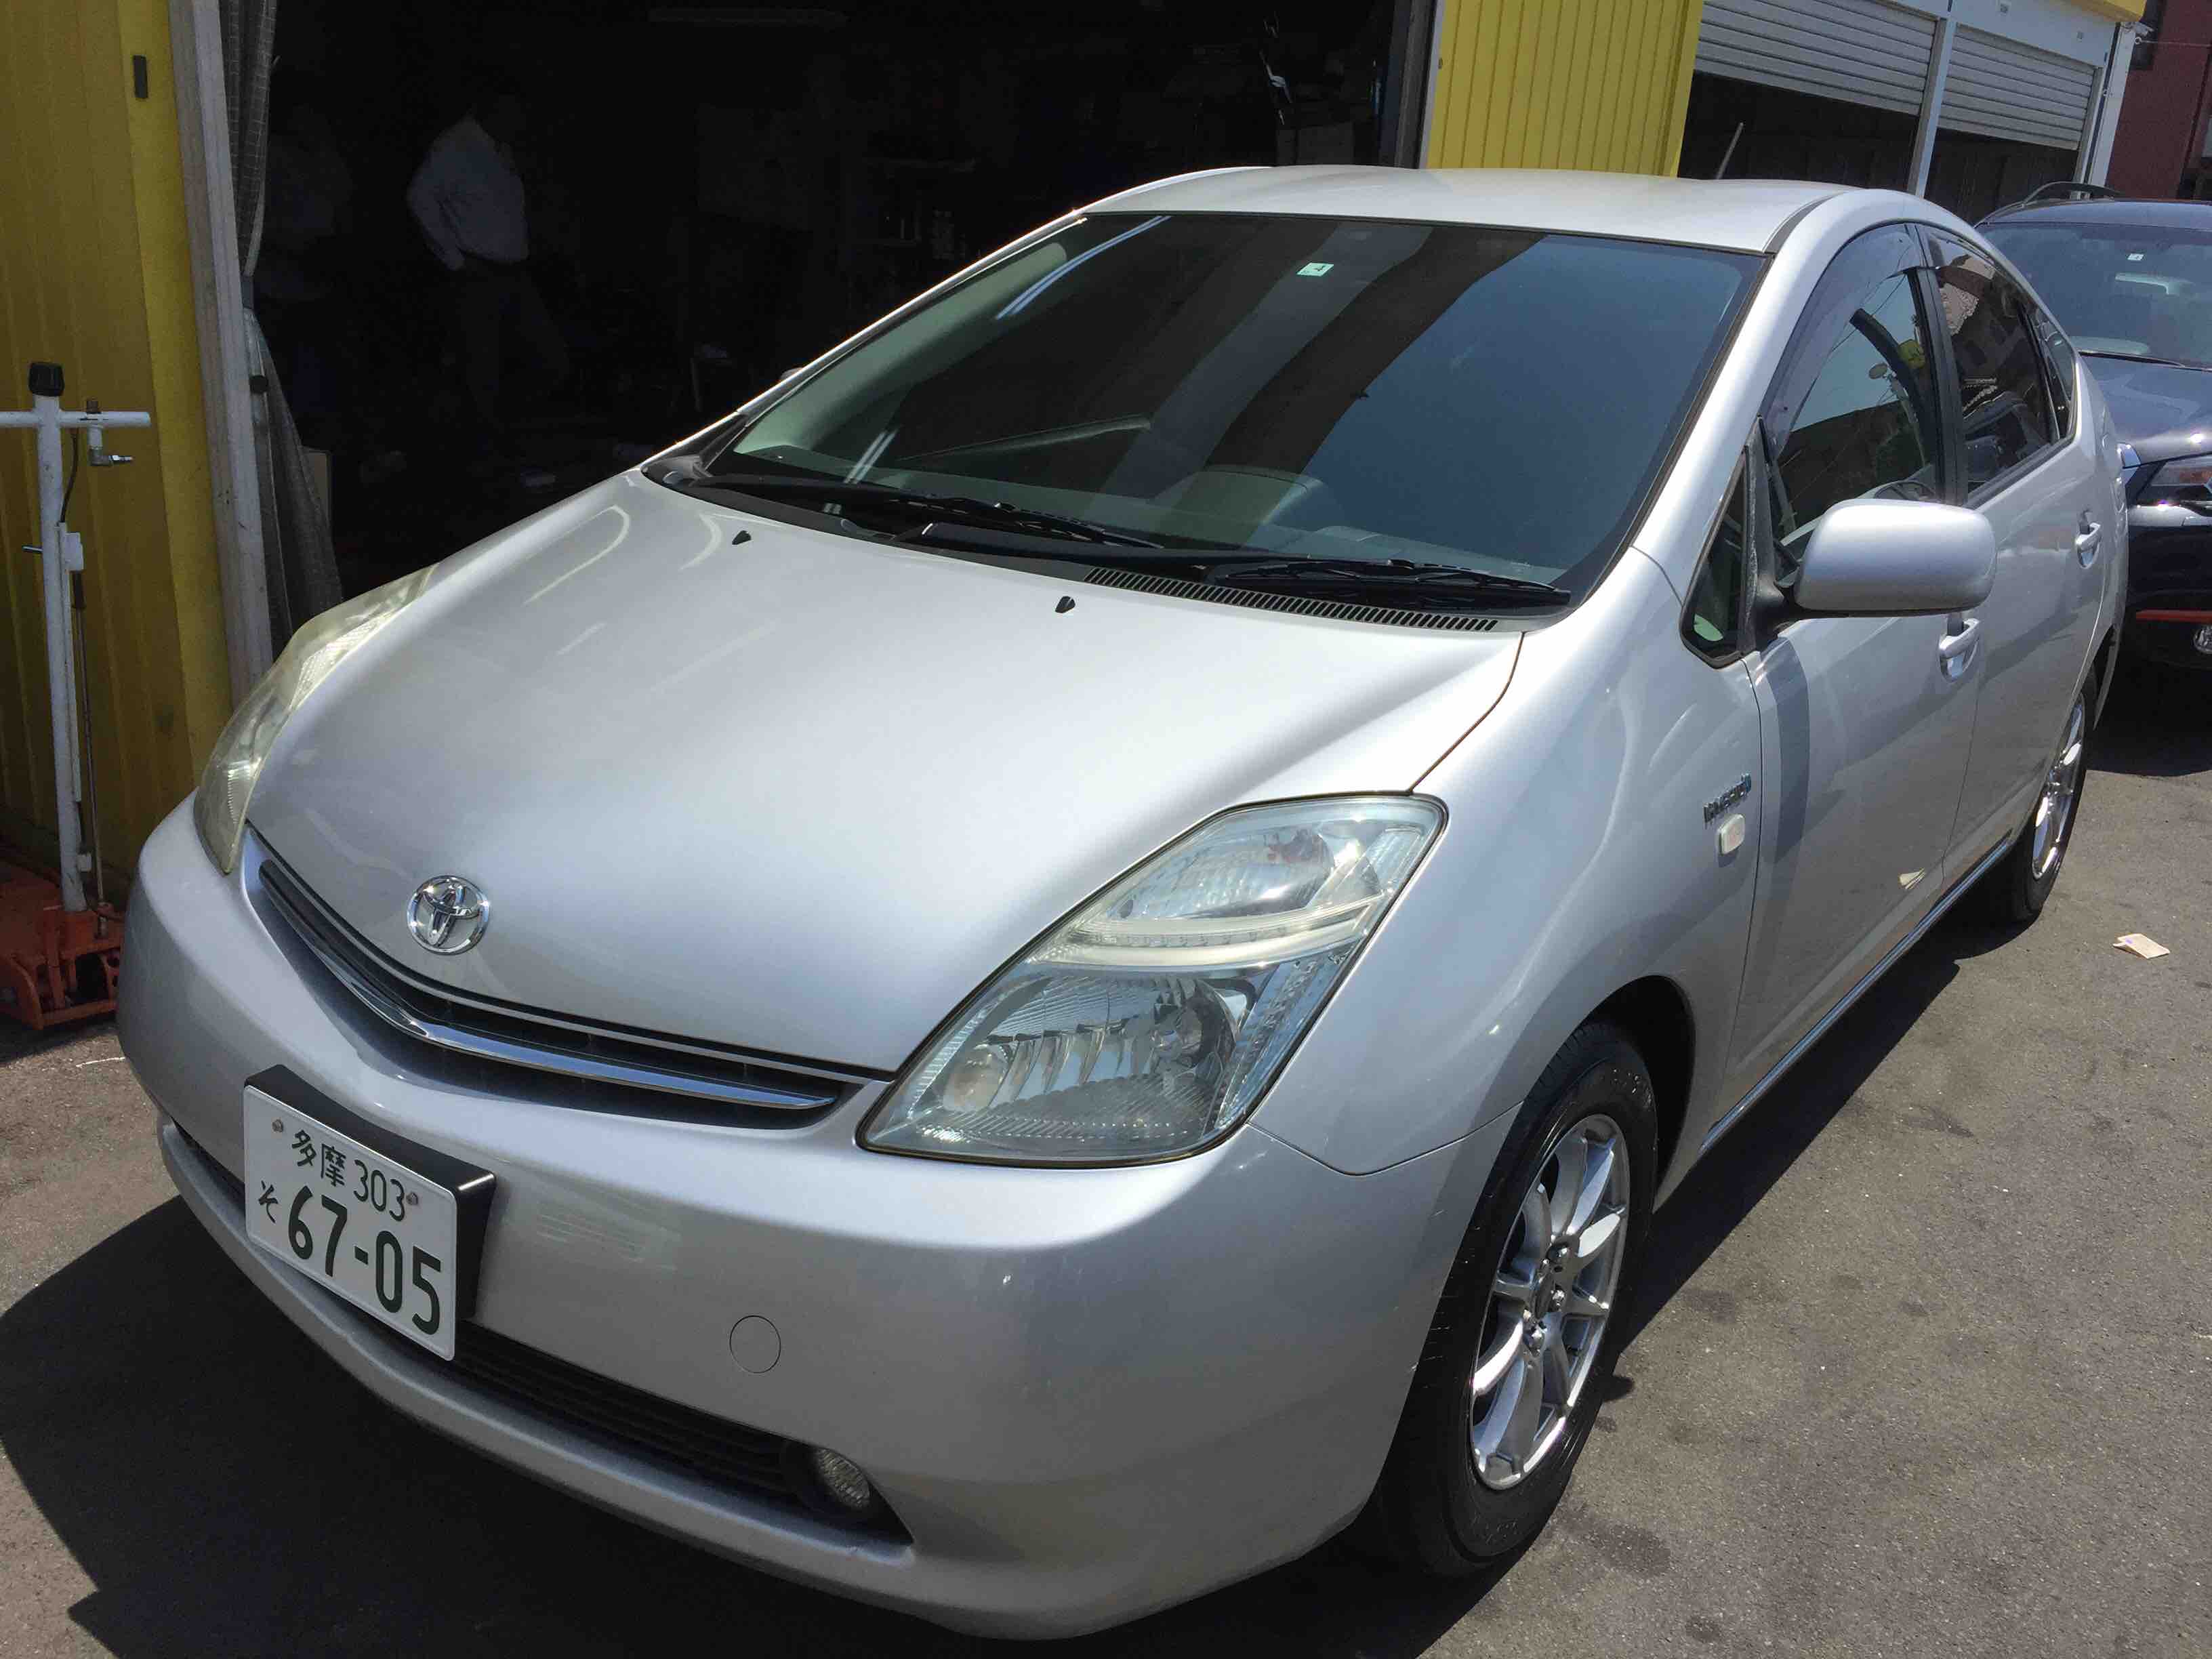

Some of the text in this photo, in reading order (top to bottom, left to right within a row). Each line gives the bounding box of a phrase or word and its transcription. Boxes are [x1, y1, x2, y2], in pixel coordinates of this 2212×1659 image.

[292, 1130, 406, 1222] 多摩 303
[258, 1180, 441, 1335] そ 67-05
